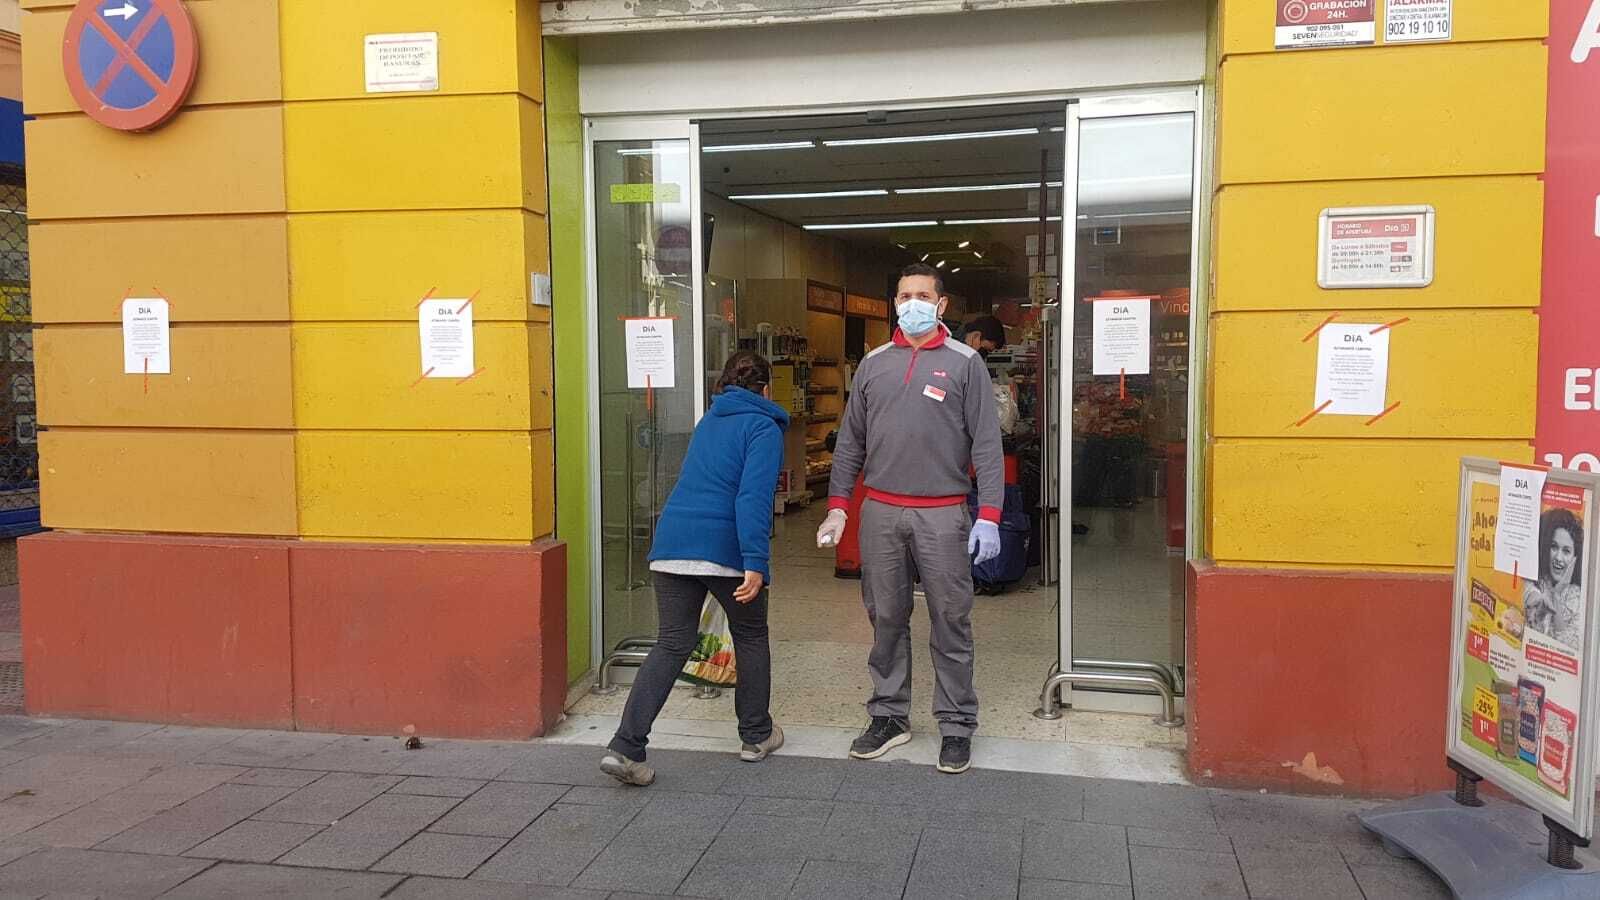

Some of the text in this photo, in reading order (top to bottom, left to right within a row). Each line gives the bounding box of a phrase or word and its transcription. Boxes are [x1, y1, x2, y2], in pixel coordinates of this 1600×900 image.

[1389, 20, 1448, 35] 902 19 10 10
